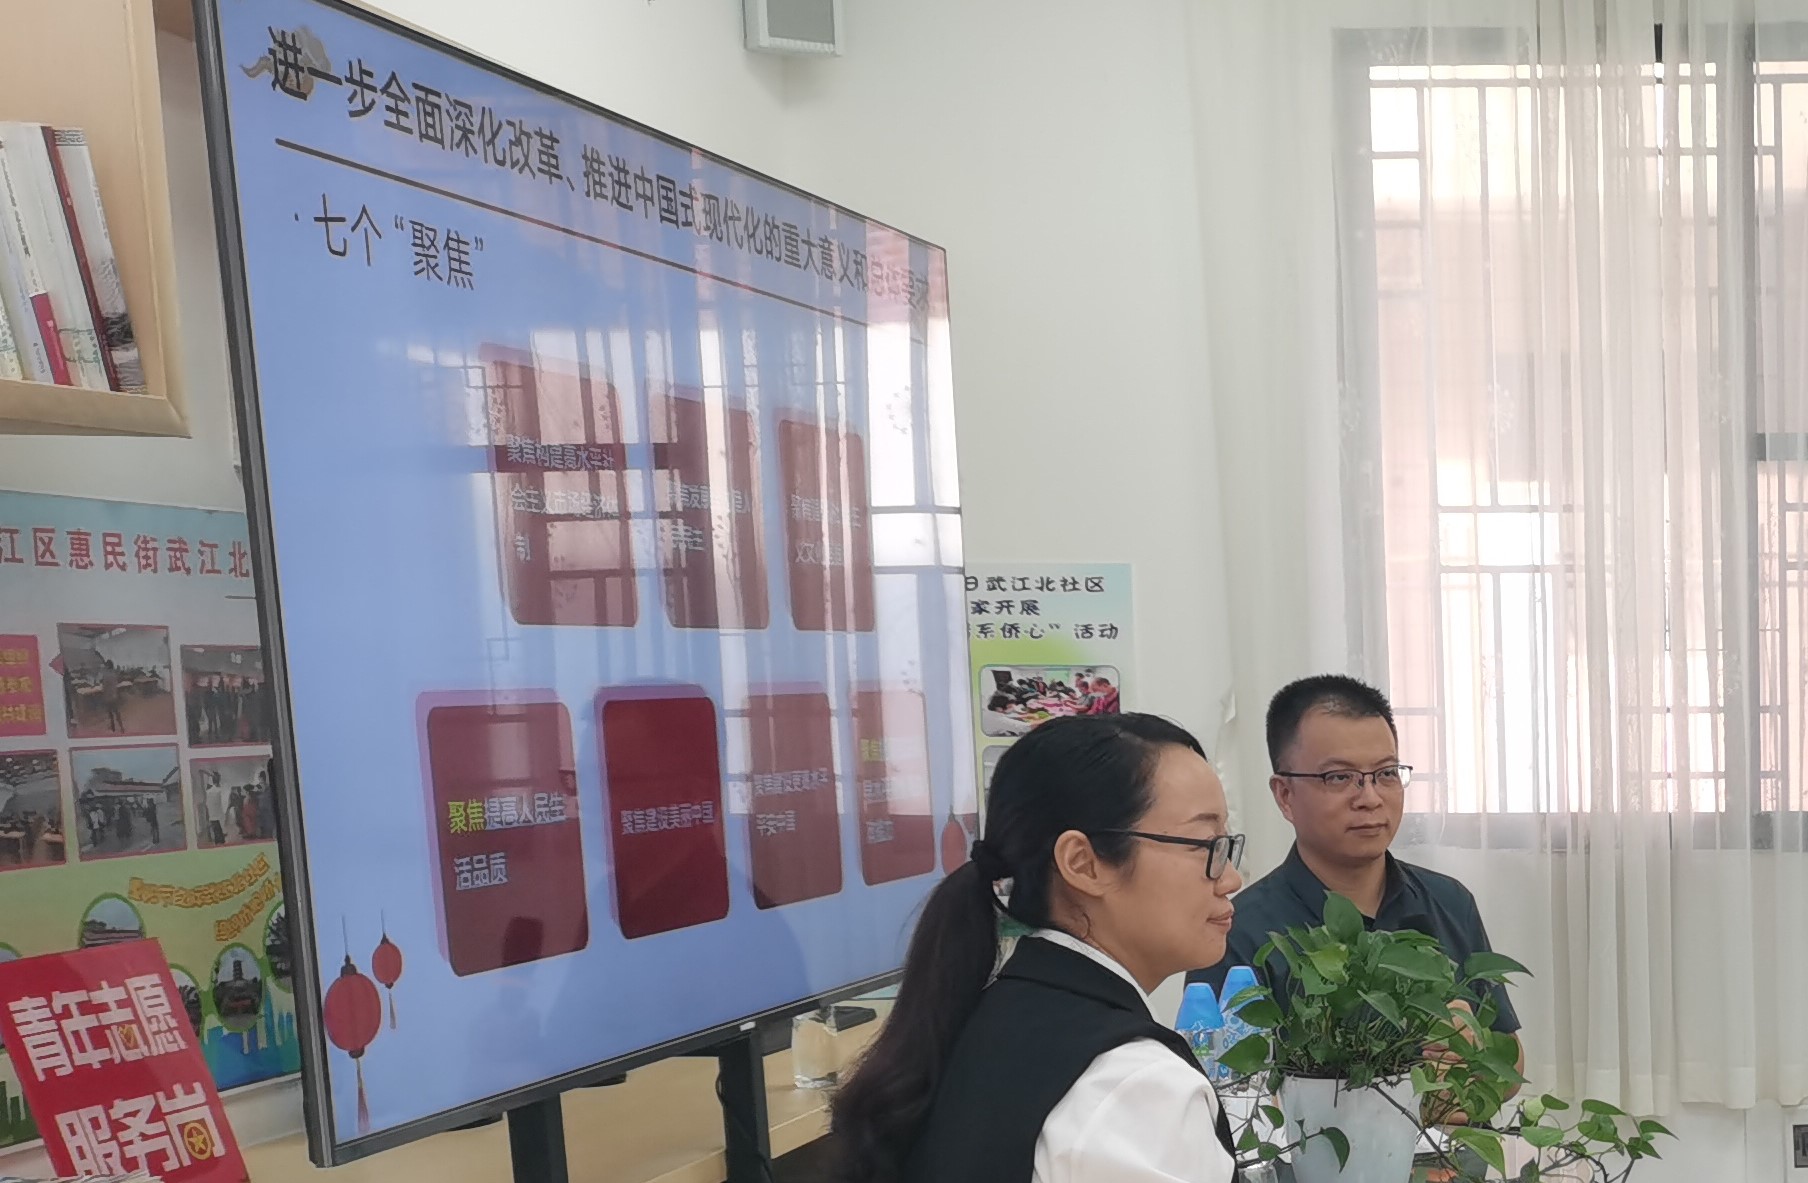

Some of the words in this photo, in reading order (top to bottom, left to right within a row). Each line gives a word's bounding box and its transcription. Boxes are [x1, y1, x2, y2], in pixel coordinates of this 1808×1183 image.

[11, 972, 188, 1082] 青年志愿
[56, 1081, 225, 1177] 服务岗
